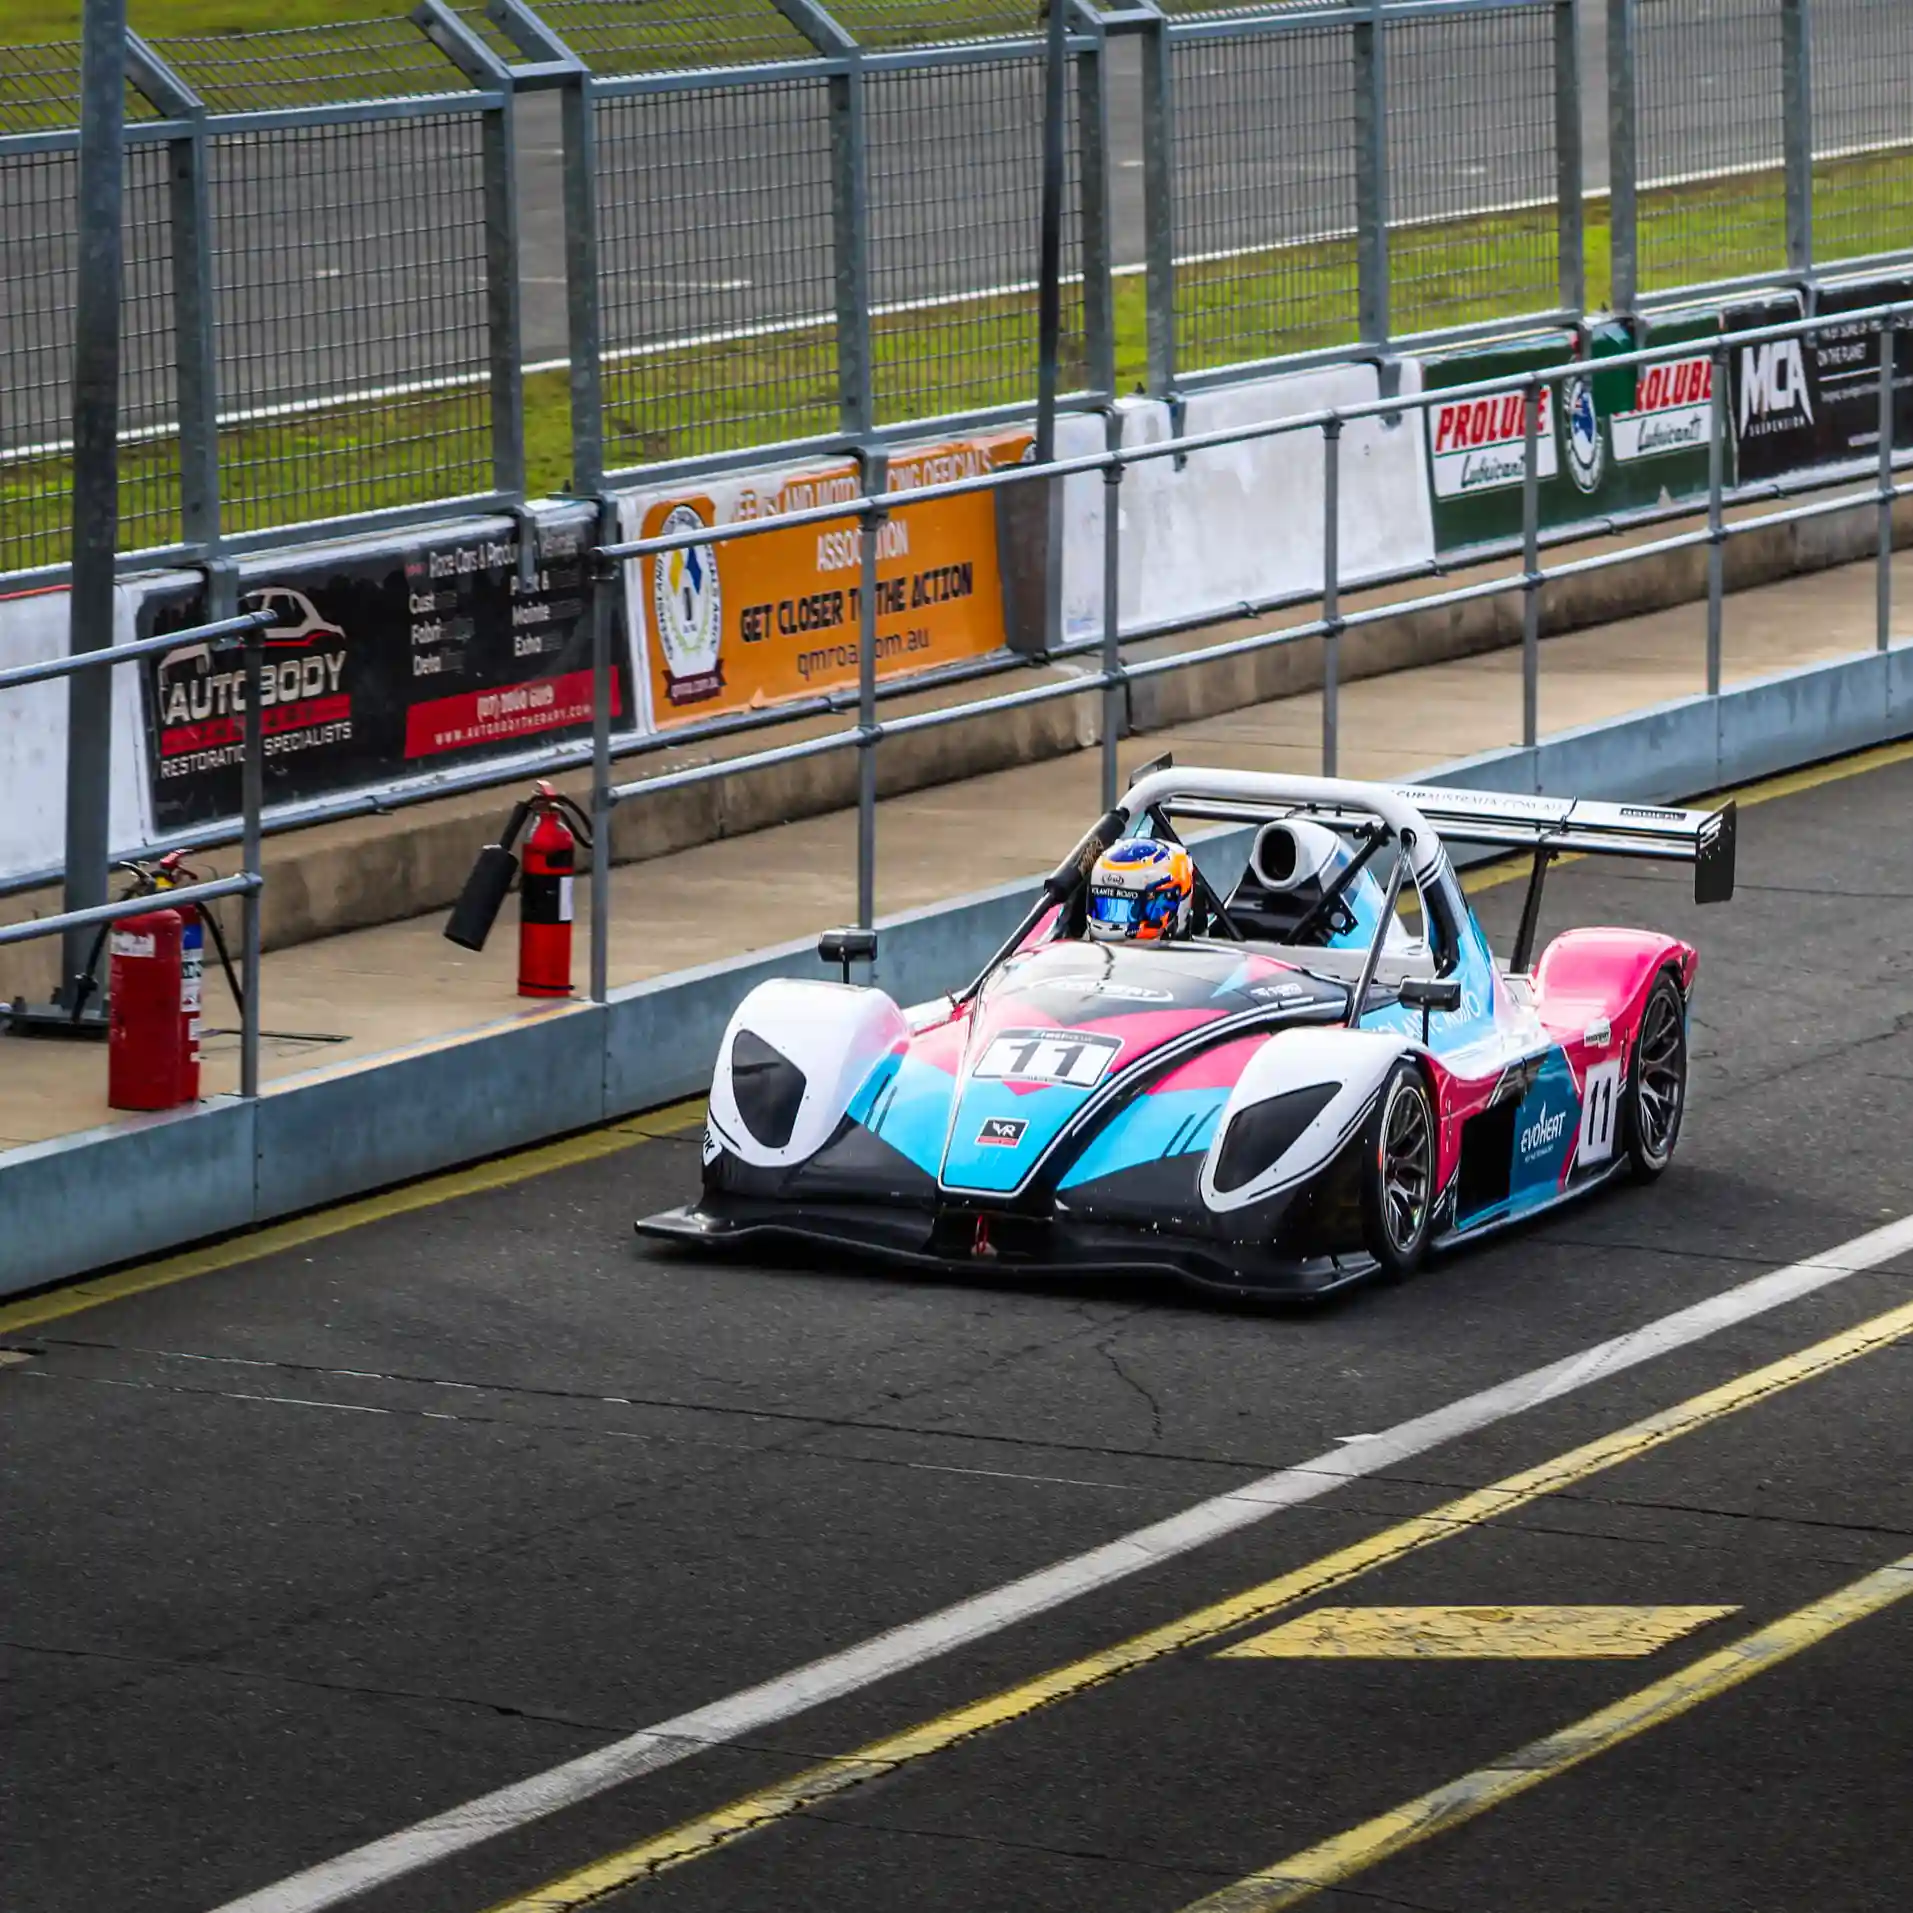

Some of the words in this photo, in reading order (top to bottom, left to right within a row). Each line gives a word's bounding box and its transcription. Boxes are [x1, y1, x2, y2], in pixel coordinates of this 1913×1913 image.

[1740, 338, 1815, 439] MCA
[1749, 415, 1806, 438] SUSPENSION
[741, 603, 773, 643] GET
[777, 590, 844, 636] CLOSER
[911, 561, 974, 609] ACTION
[160, 744, 247, 779] RESTORATIO
[263, 721, 353, 757] SPECIALISTS
[1009, 1040, 1086, 1078] 11
[1520, 1102, 1567, 1153] EVOHEAT
[1587, 1076, 1613, 1147] 11
